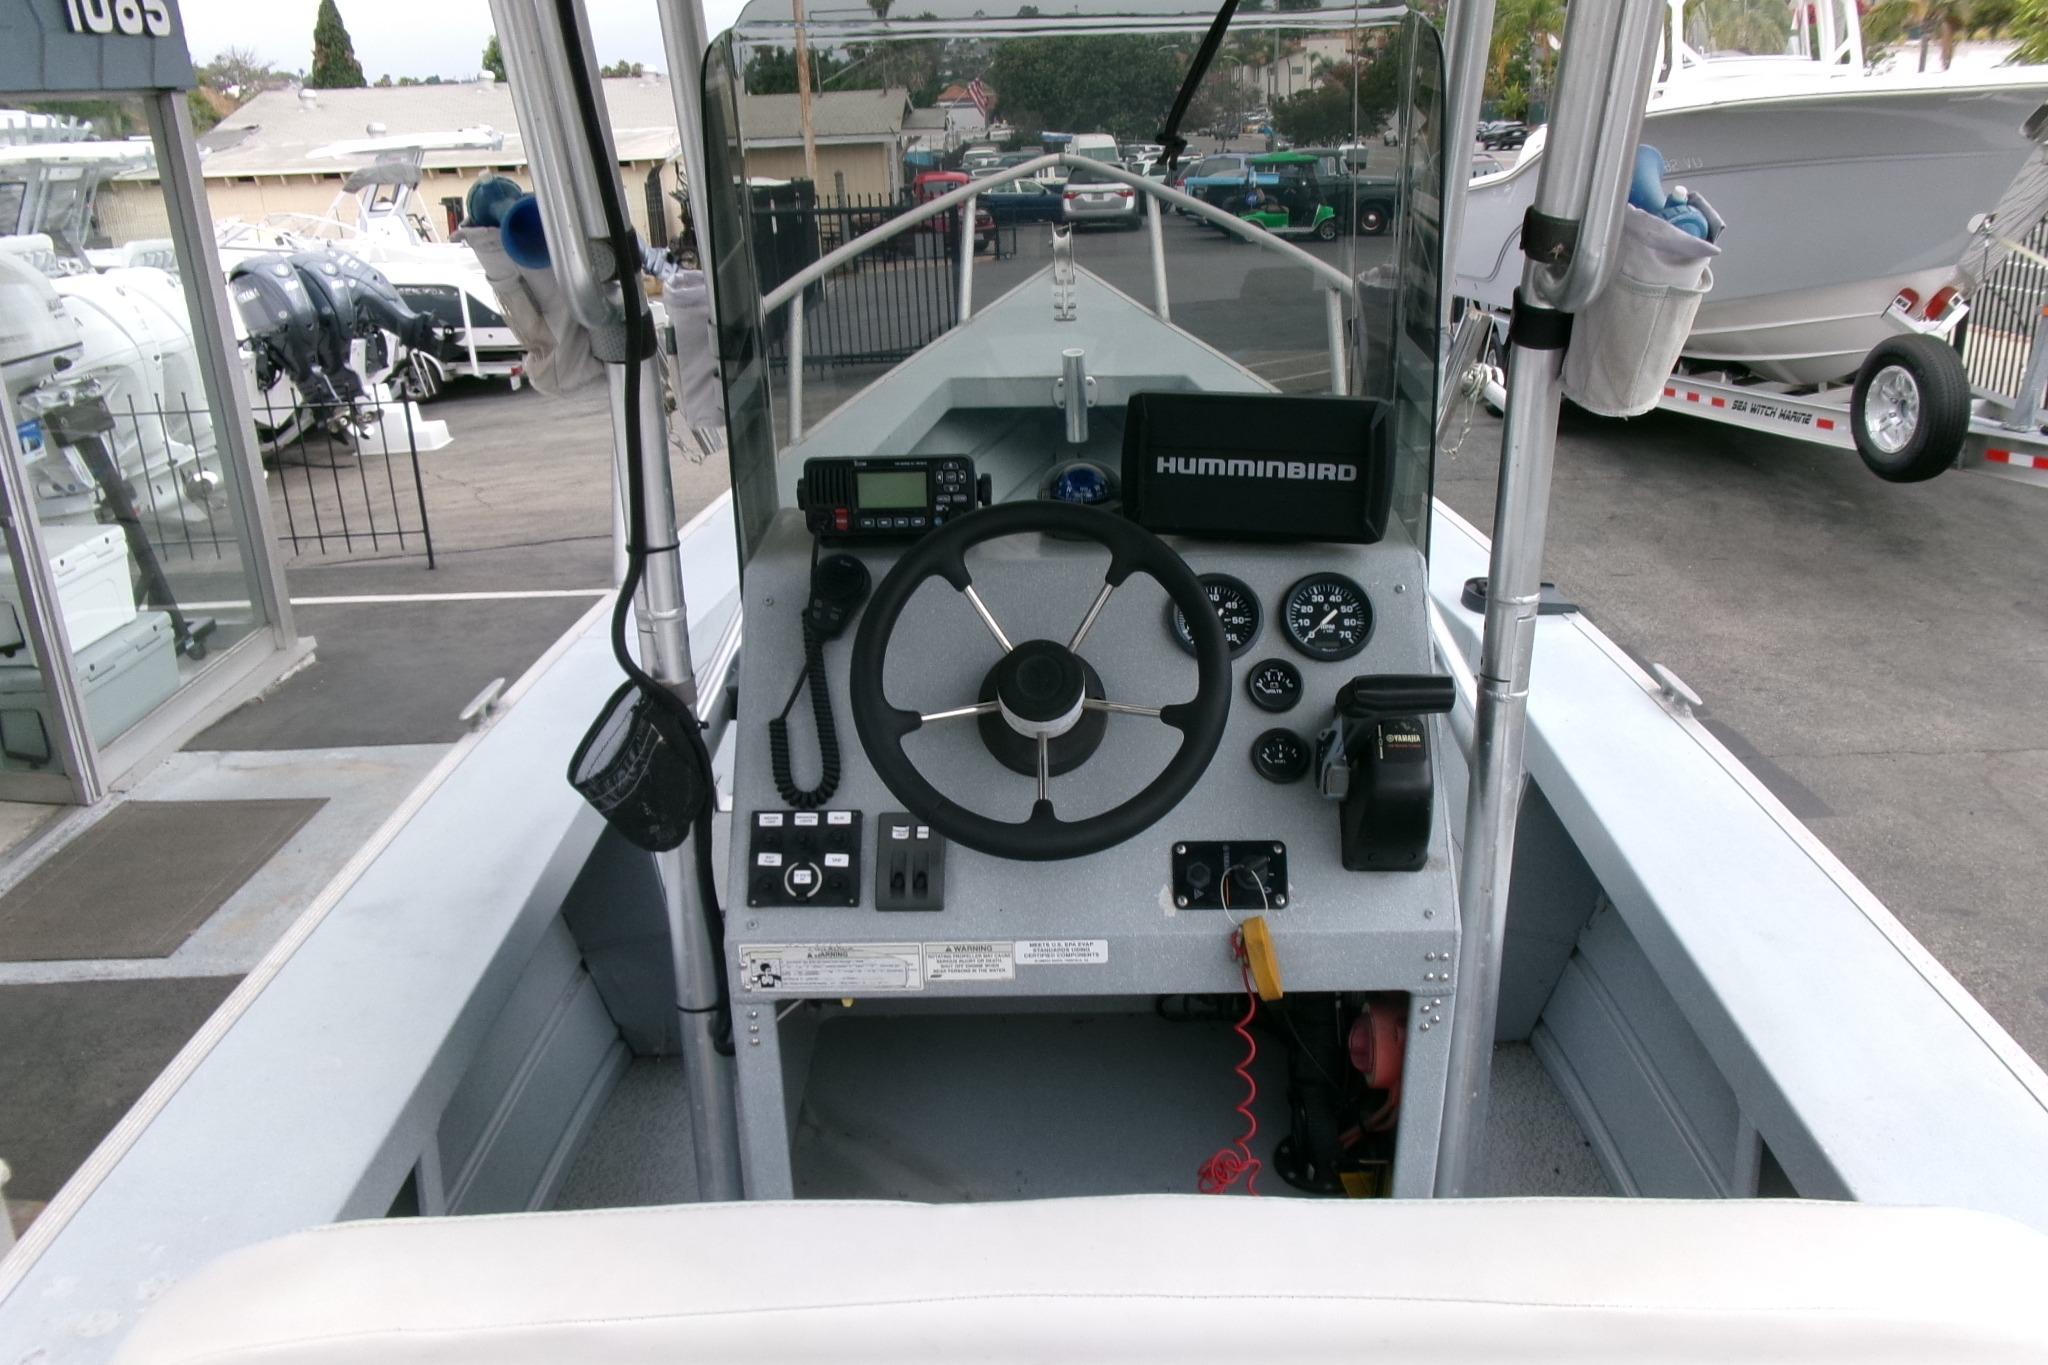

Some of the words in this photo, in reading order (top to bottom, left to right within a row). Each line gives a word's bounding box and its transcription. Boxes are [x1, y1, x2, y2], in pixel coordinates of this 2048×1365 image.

[1732, 400, 1748, 412] SEA
[1750, 402, 1777, 418] WITCH
[1778, 409, 1813, 425] MARINE
[1156, 456, 1358, 482] HUMMINBIRD
[1393, 734, 1421, 743] YAMAHA
